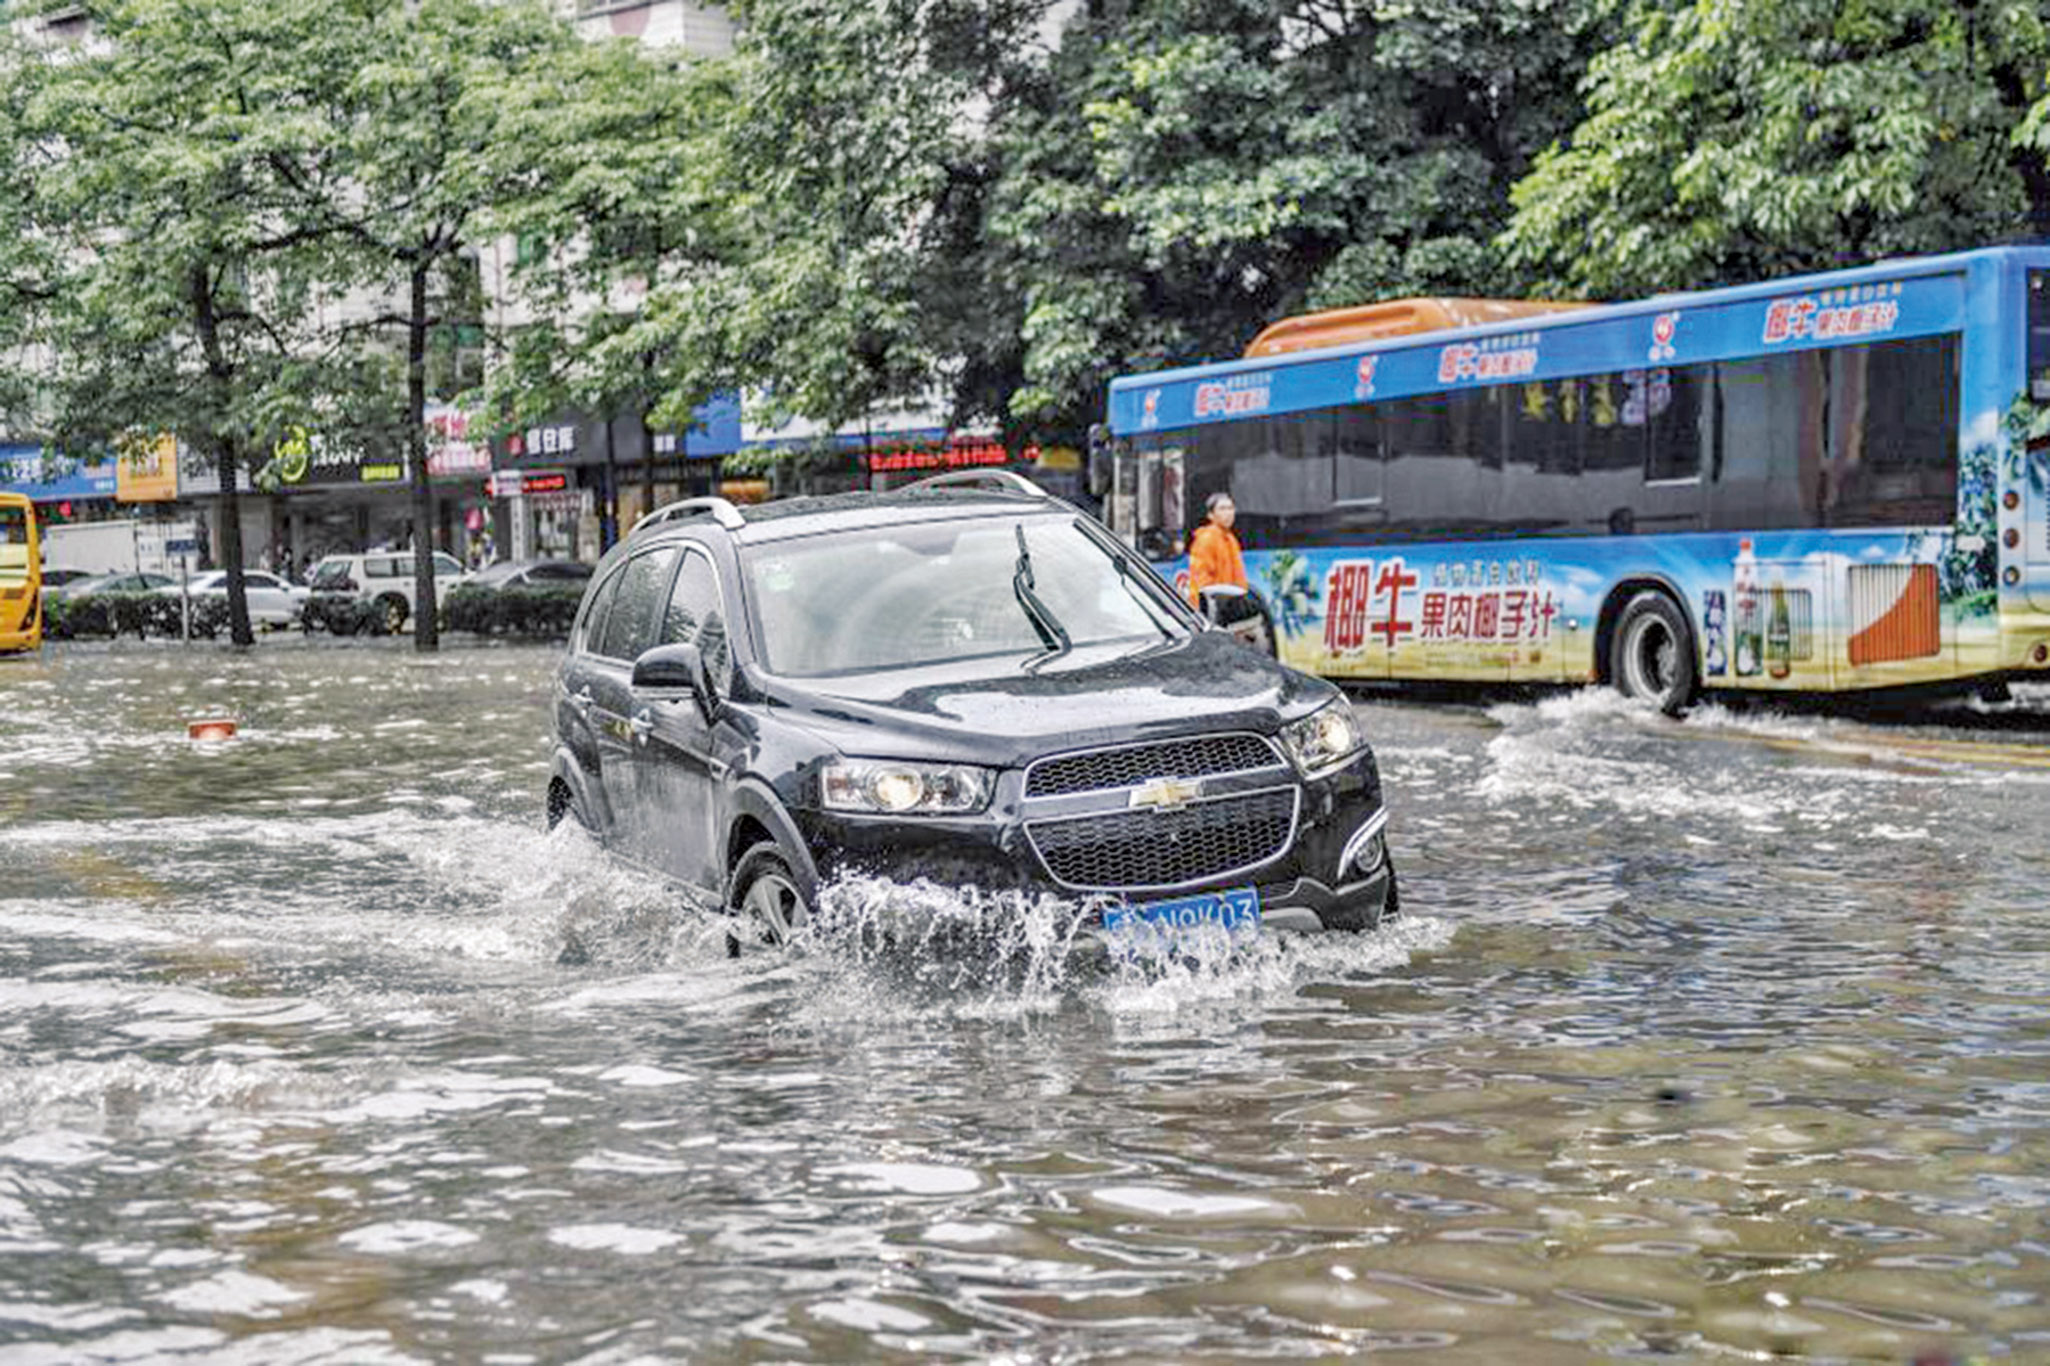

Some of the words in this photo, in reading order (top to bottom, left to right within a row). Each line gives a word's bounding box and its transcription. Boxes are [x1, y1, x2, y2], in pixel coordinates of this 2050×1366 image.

[1323, 560, 1417, 652] 椰牛
[1420, 590, 1555, 639] 果肉椰子汁
